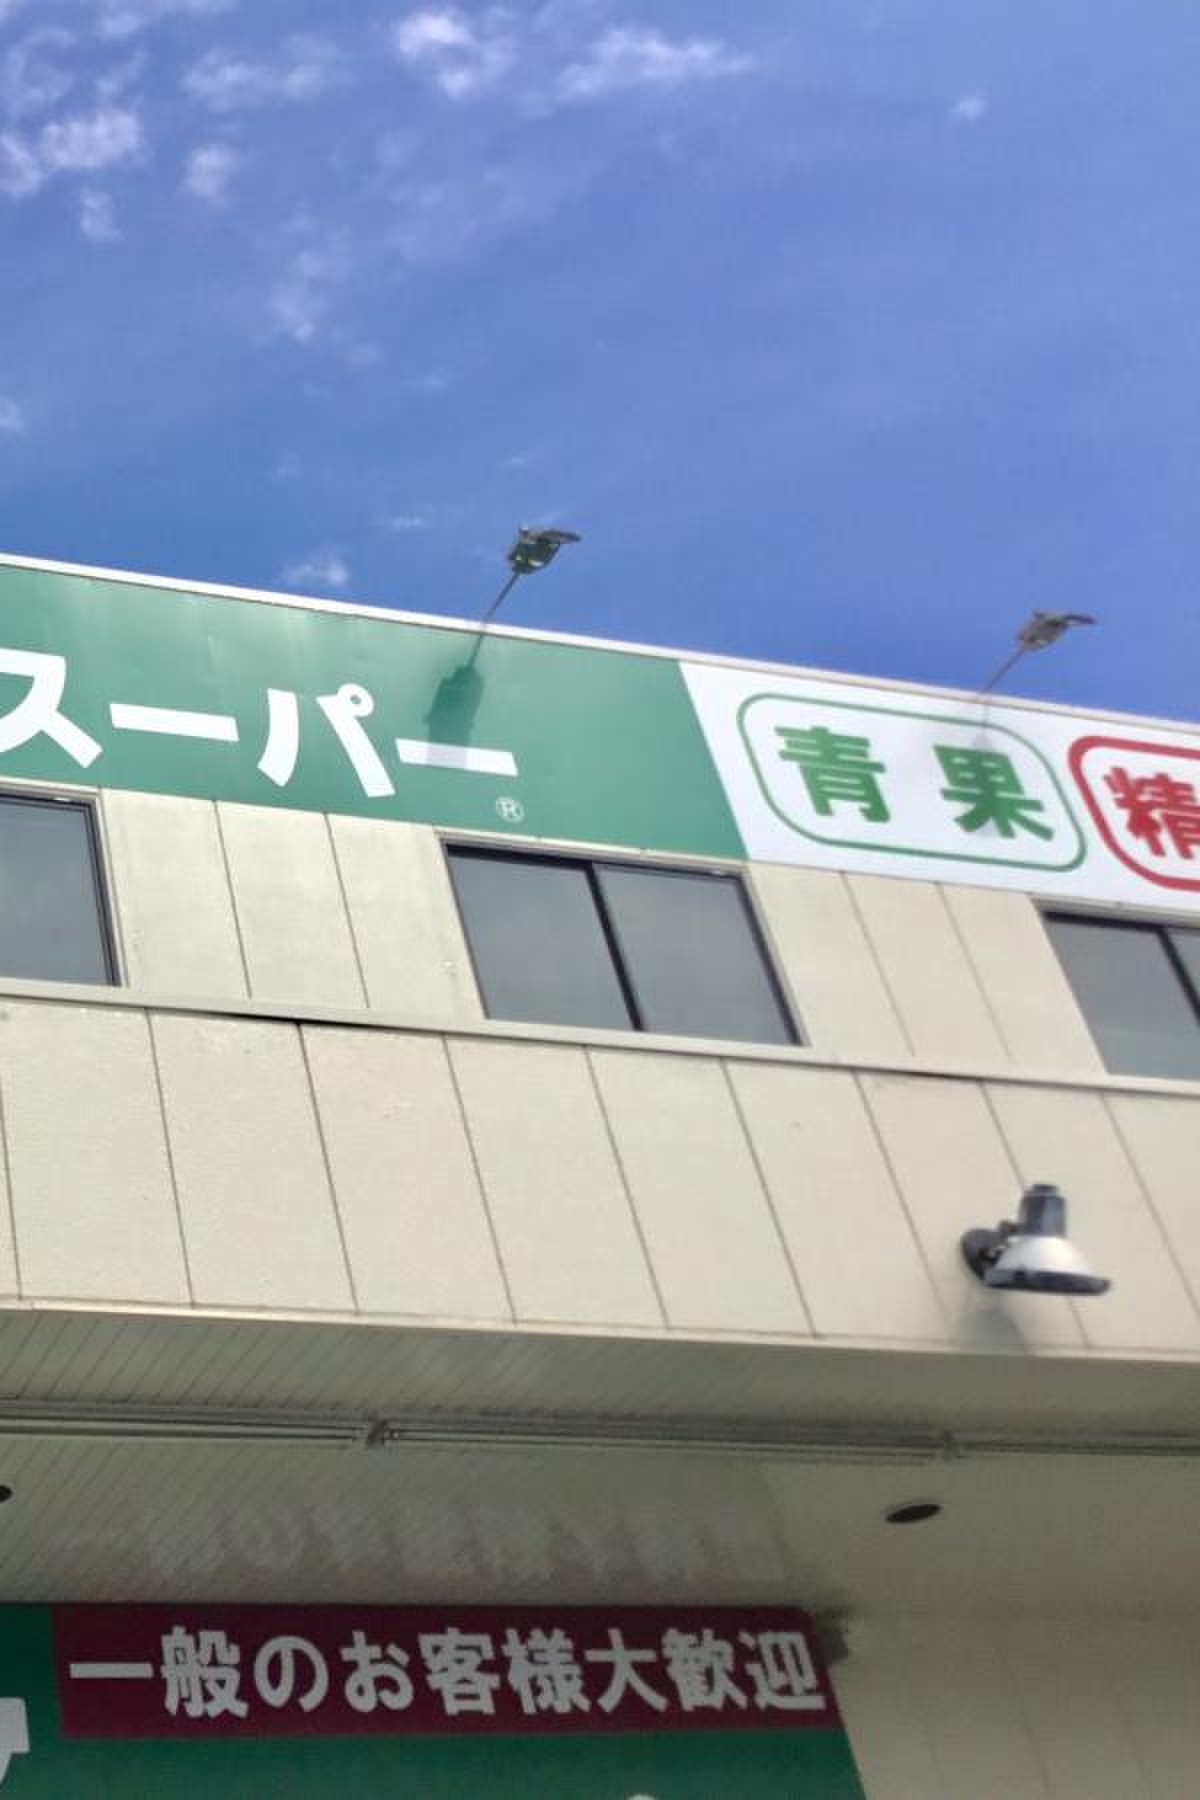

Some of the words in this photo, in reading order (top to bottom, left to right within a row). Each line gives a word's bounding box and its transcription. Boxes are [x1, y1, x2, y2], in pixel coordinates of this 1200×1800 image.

[774, 725, 1054, 842] 青果
[69, 1625, 827, 1719] 一般のお客様大歓迎
